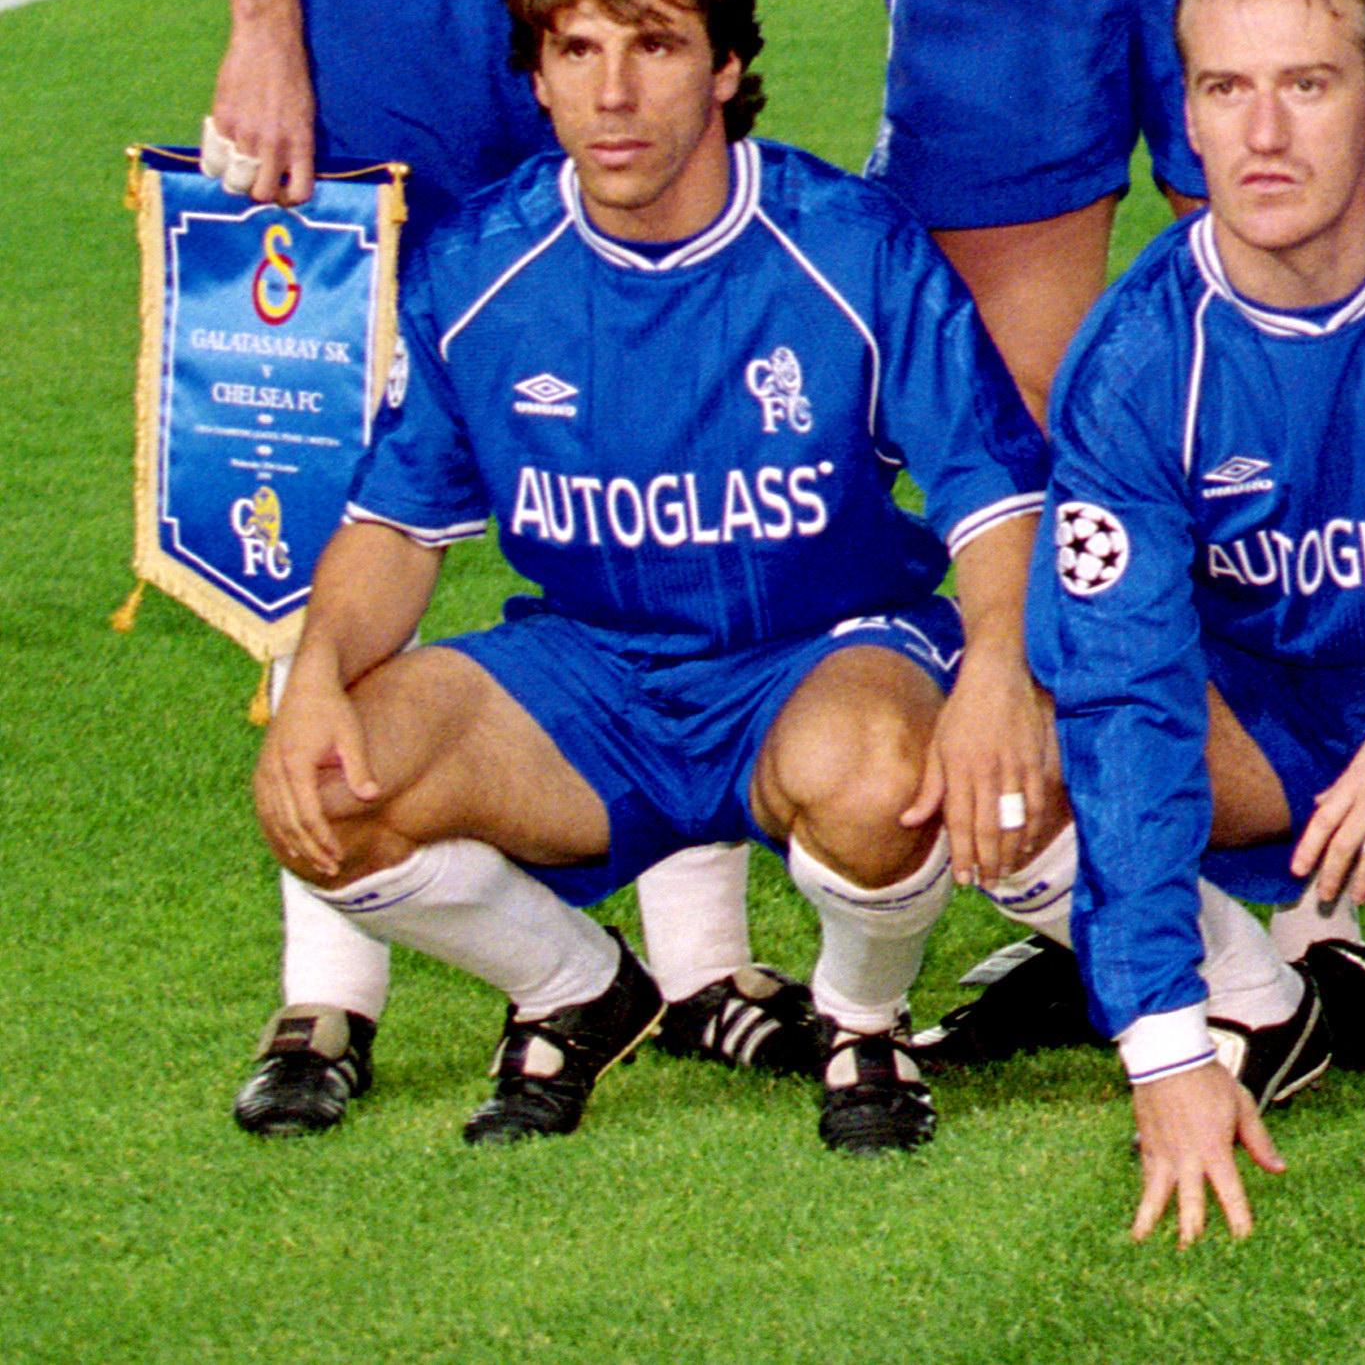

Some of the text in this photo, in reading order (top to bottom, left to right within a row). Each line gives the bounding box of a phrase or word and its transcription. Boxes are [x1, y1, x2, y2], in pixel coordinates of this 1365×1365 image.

[191, 328, 350, 363] GALATASARAY SK
[212, 382, 323, 412] CHELSEA FC
[511, 466, 828, 547] AUTOGLASS
